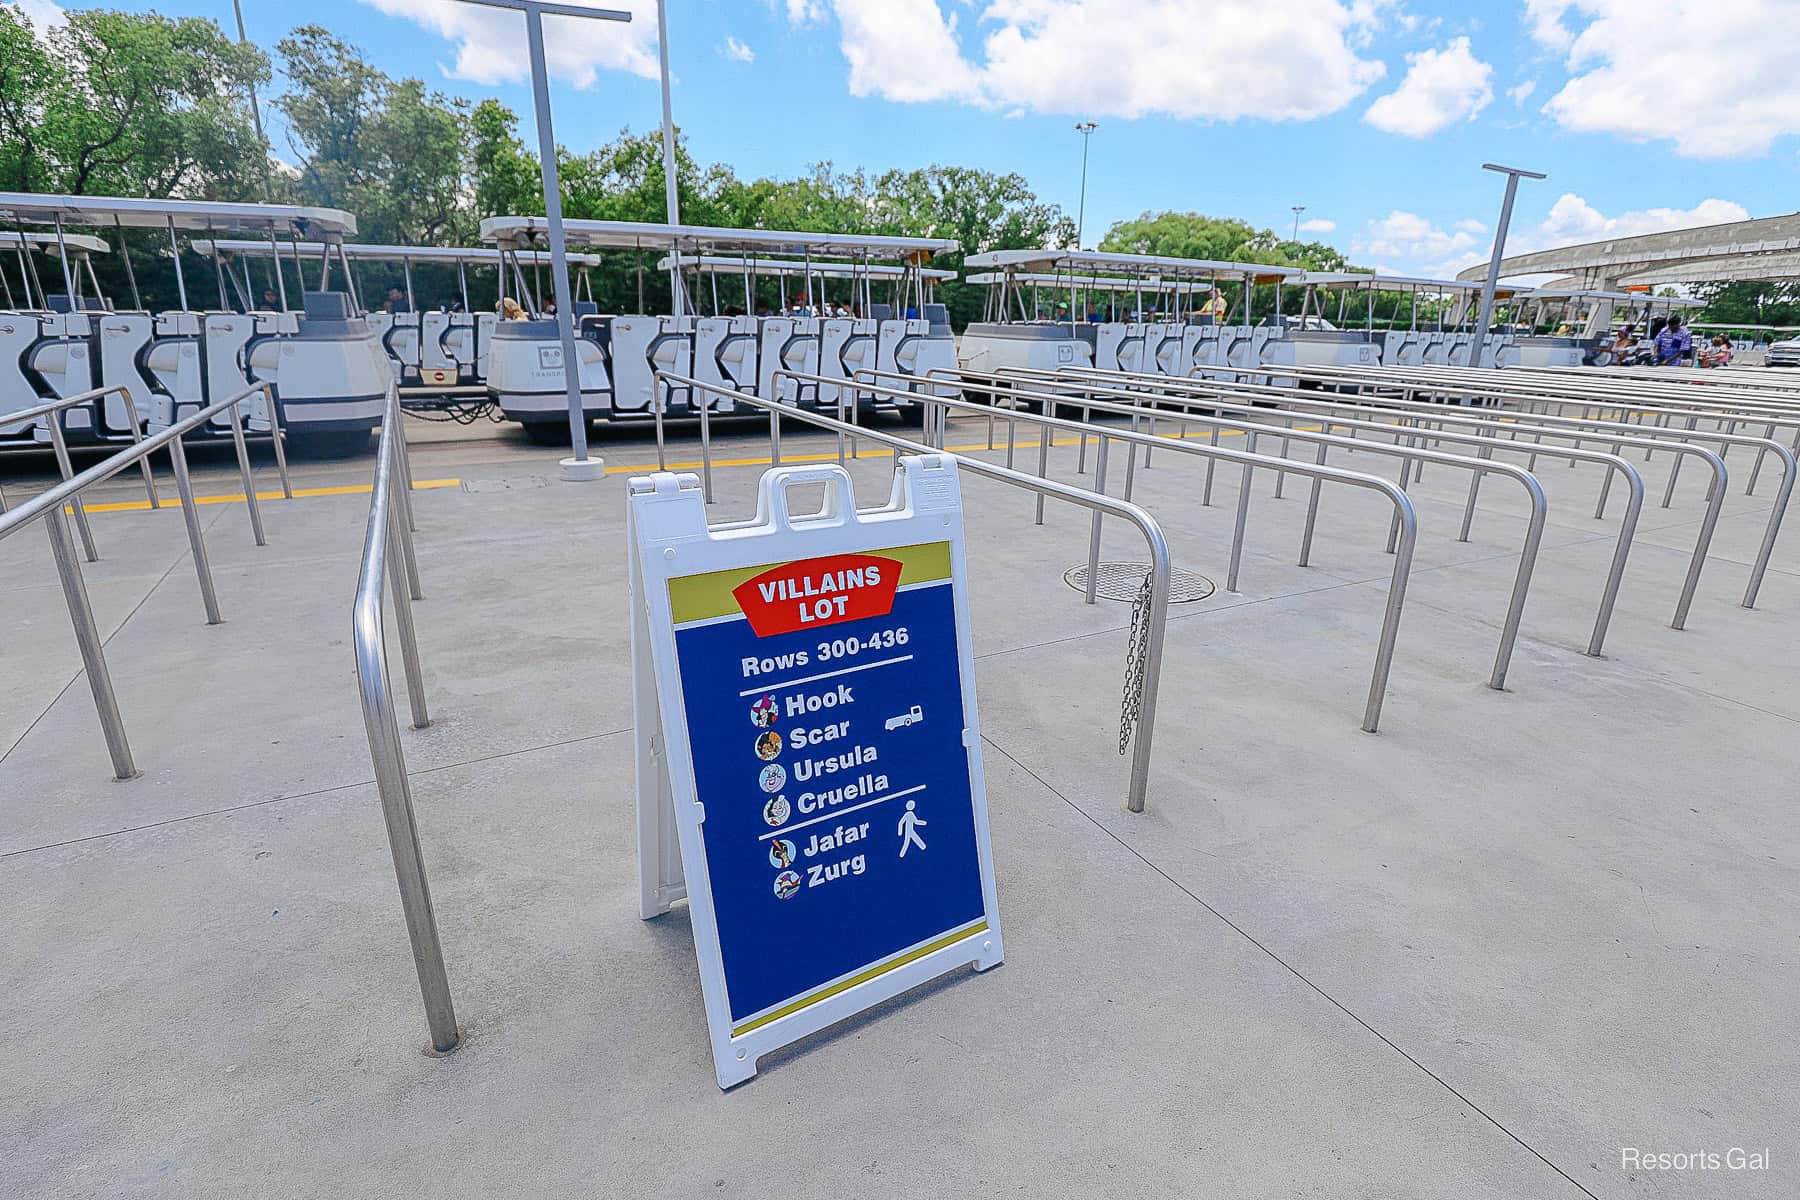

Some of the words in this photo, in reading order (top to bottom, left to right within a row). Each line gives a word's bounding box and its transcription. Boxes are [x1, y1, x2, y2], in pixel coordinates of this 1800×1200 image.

[758, 566, 881, 602] VILLAINS
[800, 596, 848, 621] LOT
[741, 652, 809, 678] Rows
[817, 628, 909, 661] 300-436
[785, 685, 855, 717] Hook
[790, 720, 850, 749] Scar
[793, 745, 878, 782] Ursula
[797, 773, 889, 814] Cruella
[804, 821, 870, 857] Jafar
[807, 855, 866, 888] Zurg
